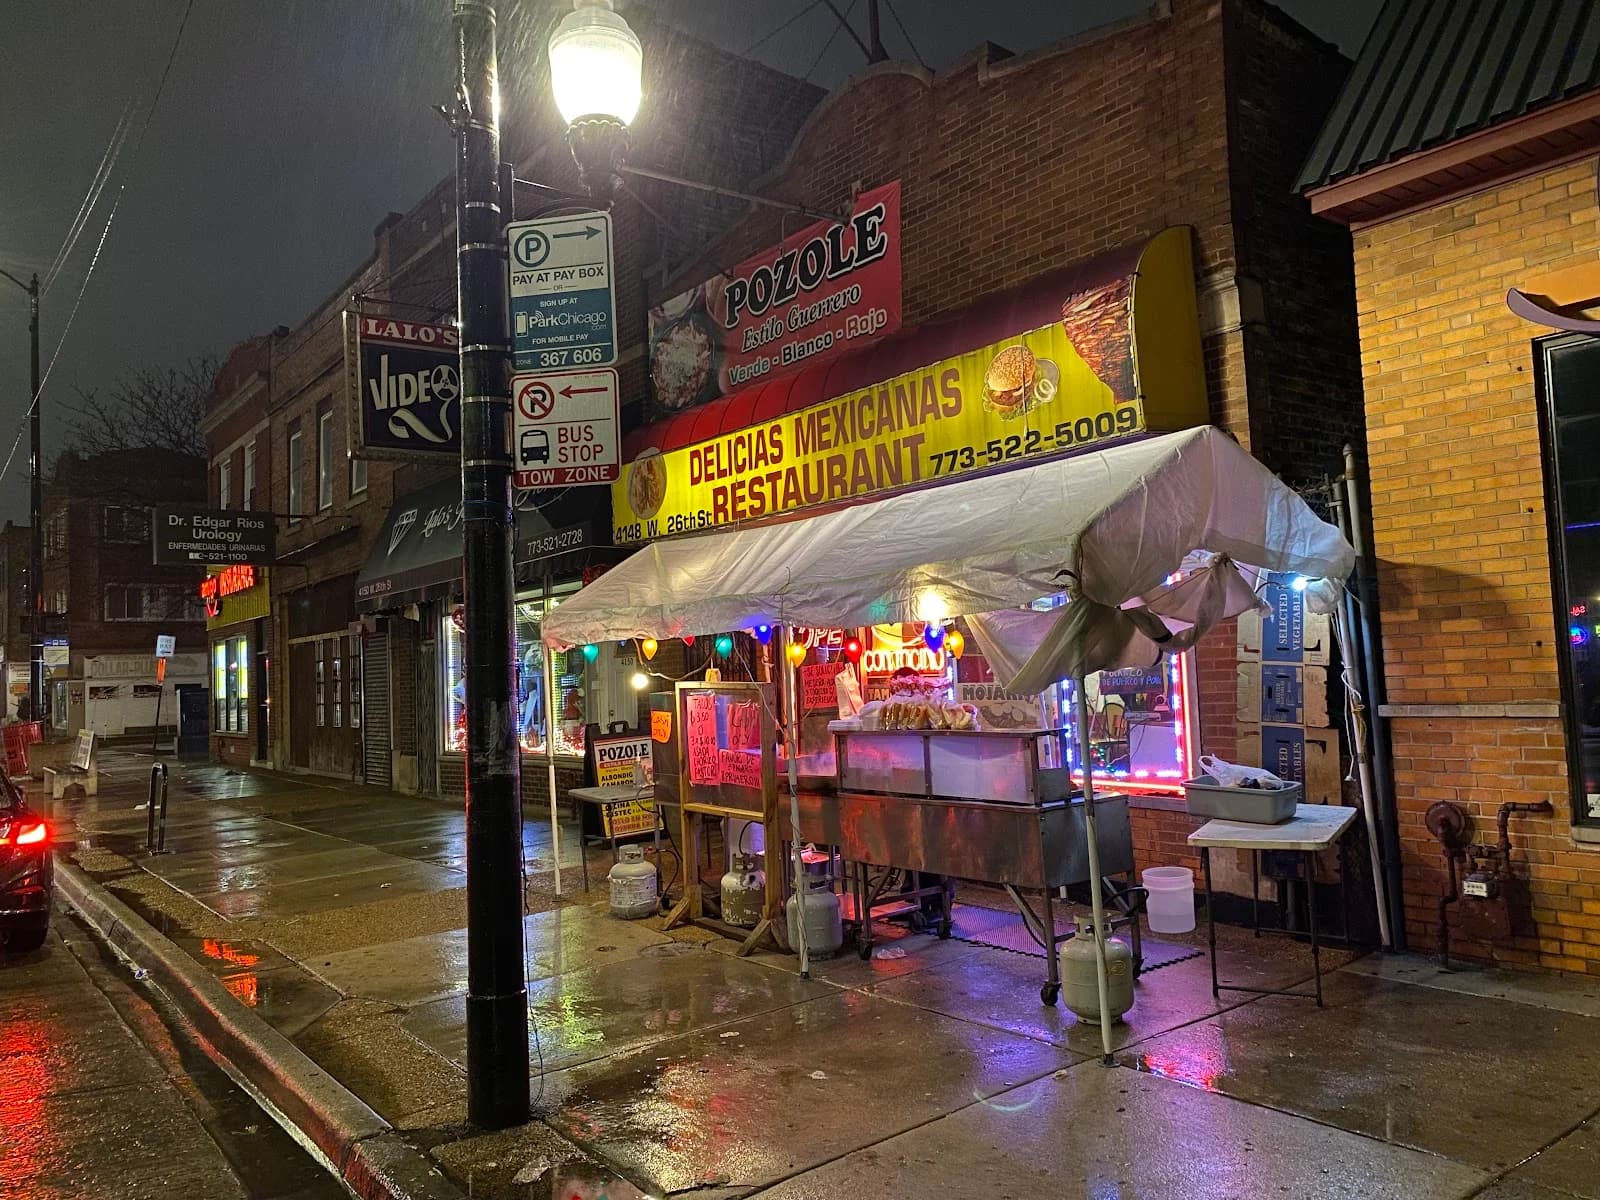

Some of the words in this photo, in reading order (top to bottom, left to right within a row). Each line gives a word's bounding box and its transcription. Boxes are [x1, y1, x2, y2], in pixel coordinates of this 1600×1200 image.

[725, 203, 887, 328] POZOLE
[513, 274, 534, 285] PAY
[536, 273, 550, 283] AT
[554, 270, 576, 281] PAY
[579, 266, 604, 278] BOX
[529, 311, 606, 328] ParkChicago
[742, 317, 783, 352] Estilo
[787, 284, 861, 332] Guerrero
[366, 319, 458, 346] LALO'S
[548, 335, 575, 343] MOBILE
[728, 357, 769, 386] Verde
[781, 333, 833, 366] Blanco
[846, 308, 888, 339] Rojo
[540, 351, 568, 366] 367
[573, 348, 602, 363] 606
[558, 425, 593, 444] BUS
[689, 424, 783, 487] DELICIAS
[795, 367, 962, 457] MEXICANAS
[930, 407, 1137, 476] 773-522-5009
[558, 444, 604, 463] STOP
[520, 470, 555, 485] TOW
[565, 466, 610, 482] ZONE
[713, 432, 926, 525] RESTAURANT
[168, 515, 187, 526] Dr.
[193, 516, 231, 529] Edgar
[237, 518, 264, 529] Rios
[616, 523, 641, 542] 4148
[647, 519, 661, 537] W.
[667, 512, 696, 533] 26th
[697, 510, 712, 527] St
[192, 529, 242, 542] Urology
[528, 529, 583, 556] 773-521-2728
[168, 542, 226, 551] ENFERMEDADES
[1279, 593, 1288, 645] SELECTED
[1292, 589, 1301, 651] VEGETABLE
[867, 688, 890, 701] TAM
[599, 744, 649, 762] POZOLE
[601, 771, 633, 782] ALBONDIG
